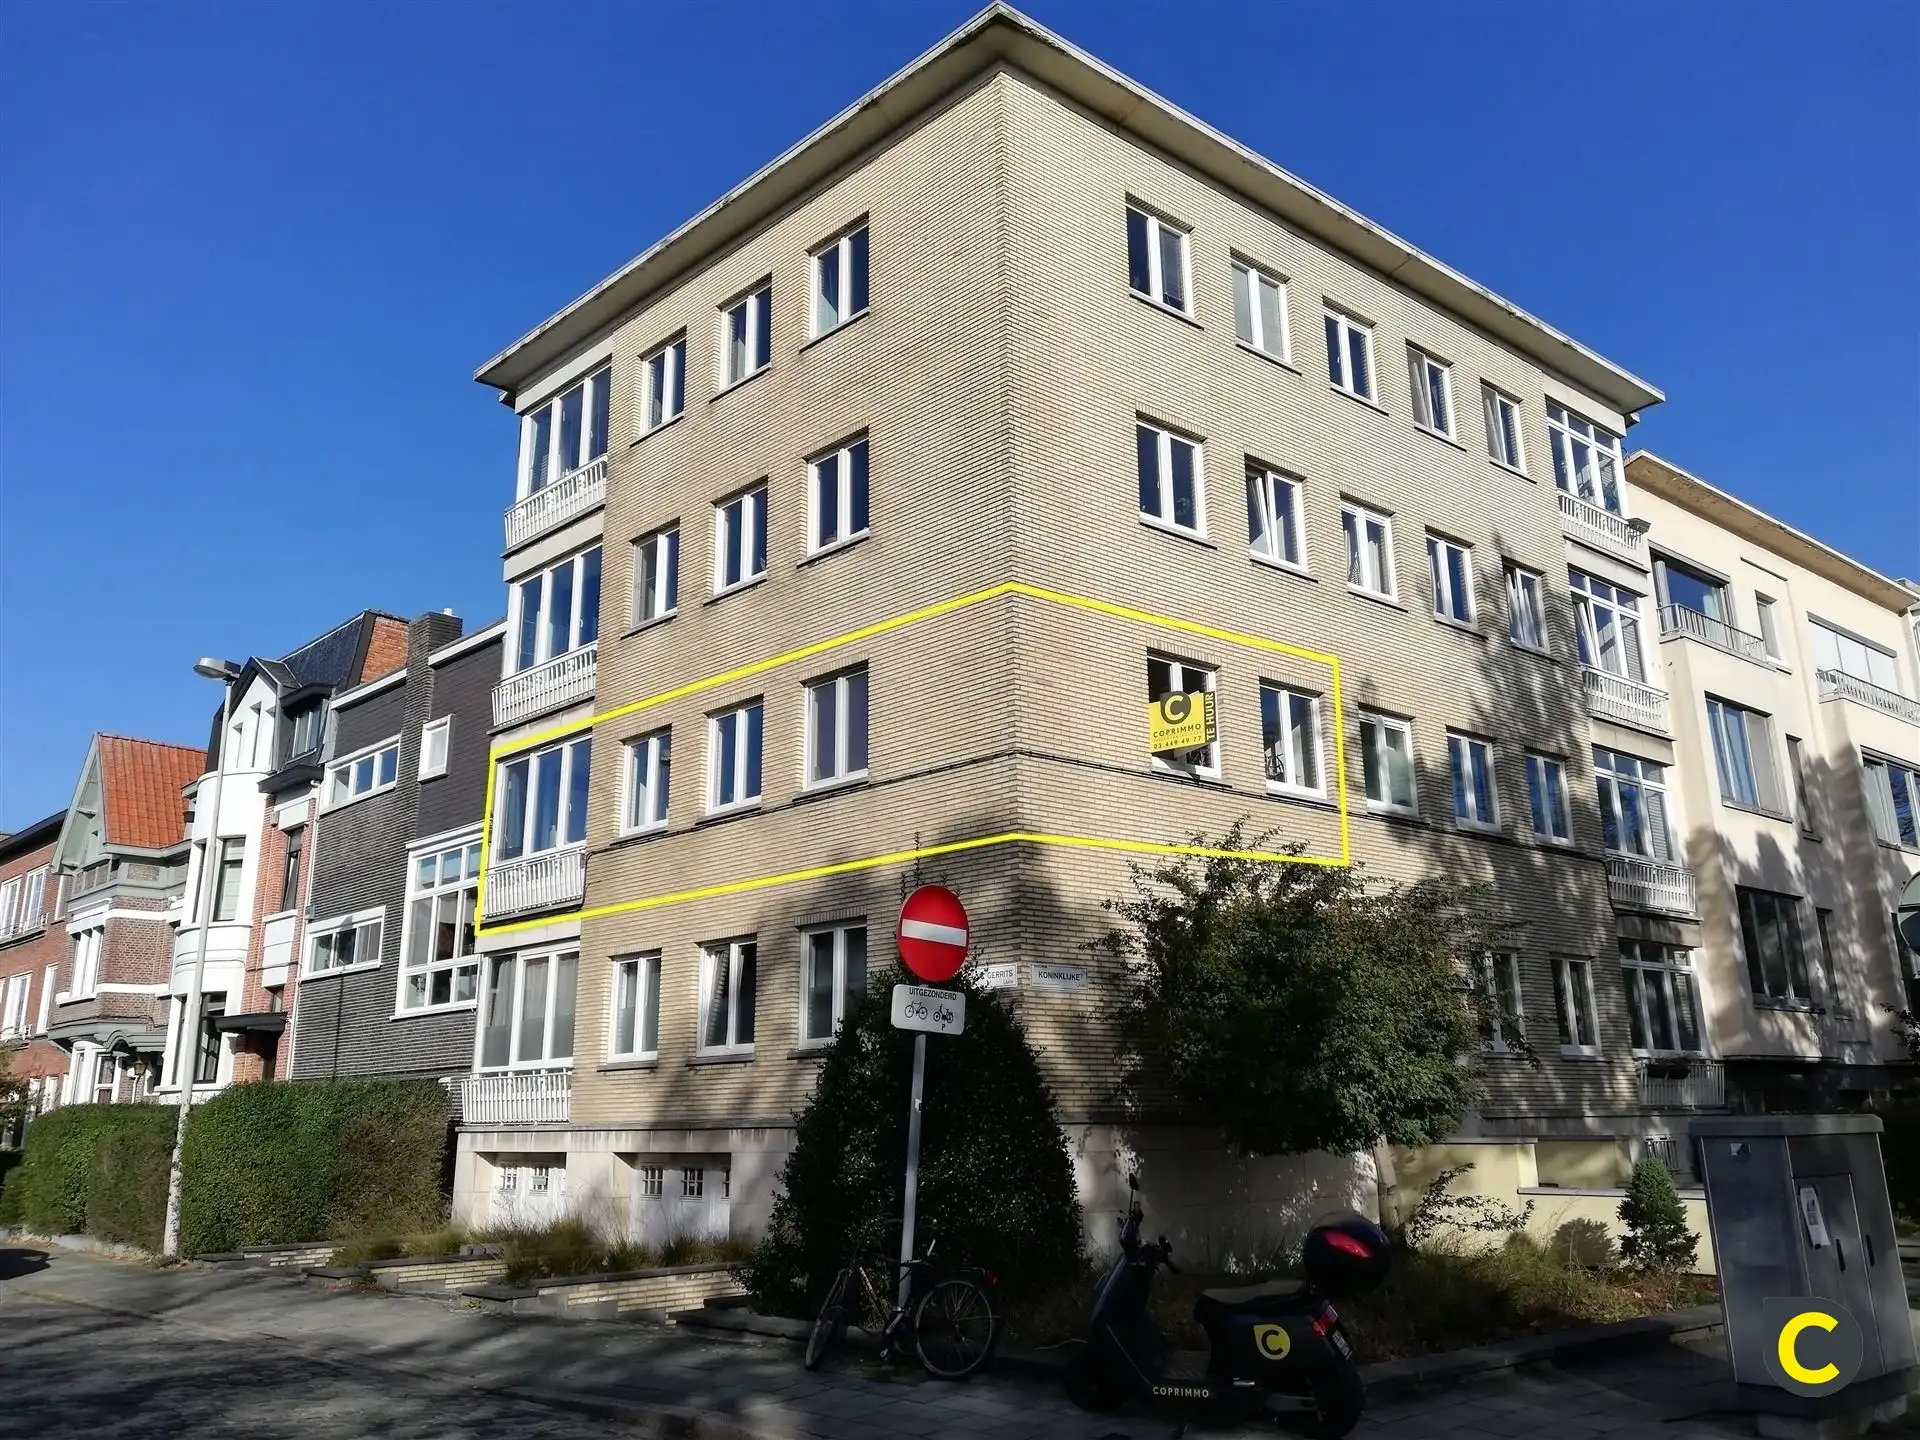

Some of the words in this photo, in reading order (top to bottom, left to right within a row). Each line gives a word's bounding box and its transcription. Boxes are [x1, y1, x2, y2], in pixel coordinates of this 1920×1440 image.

[1164, 694, 1185, 721] C
[1205, 692, 1215, 726] HUUR
[1153, 723, 1201, 738] COPRIMMO
[1206, 727, 1216, 741] TE
[987, 969, 1013, 979] GERRITS
[909, 987, 957, 1001] UITGEZONDERD
[941, 1023, 946, 1031] P
[1261, 1329, 1285, 1355] C
[1153, 1386, 1209, 1398] COPRIMMO
